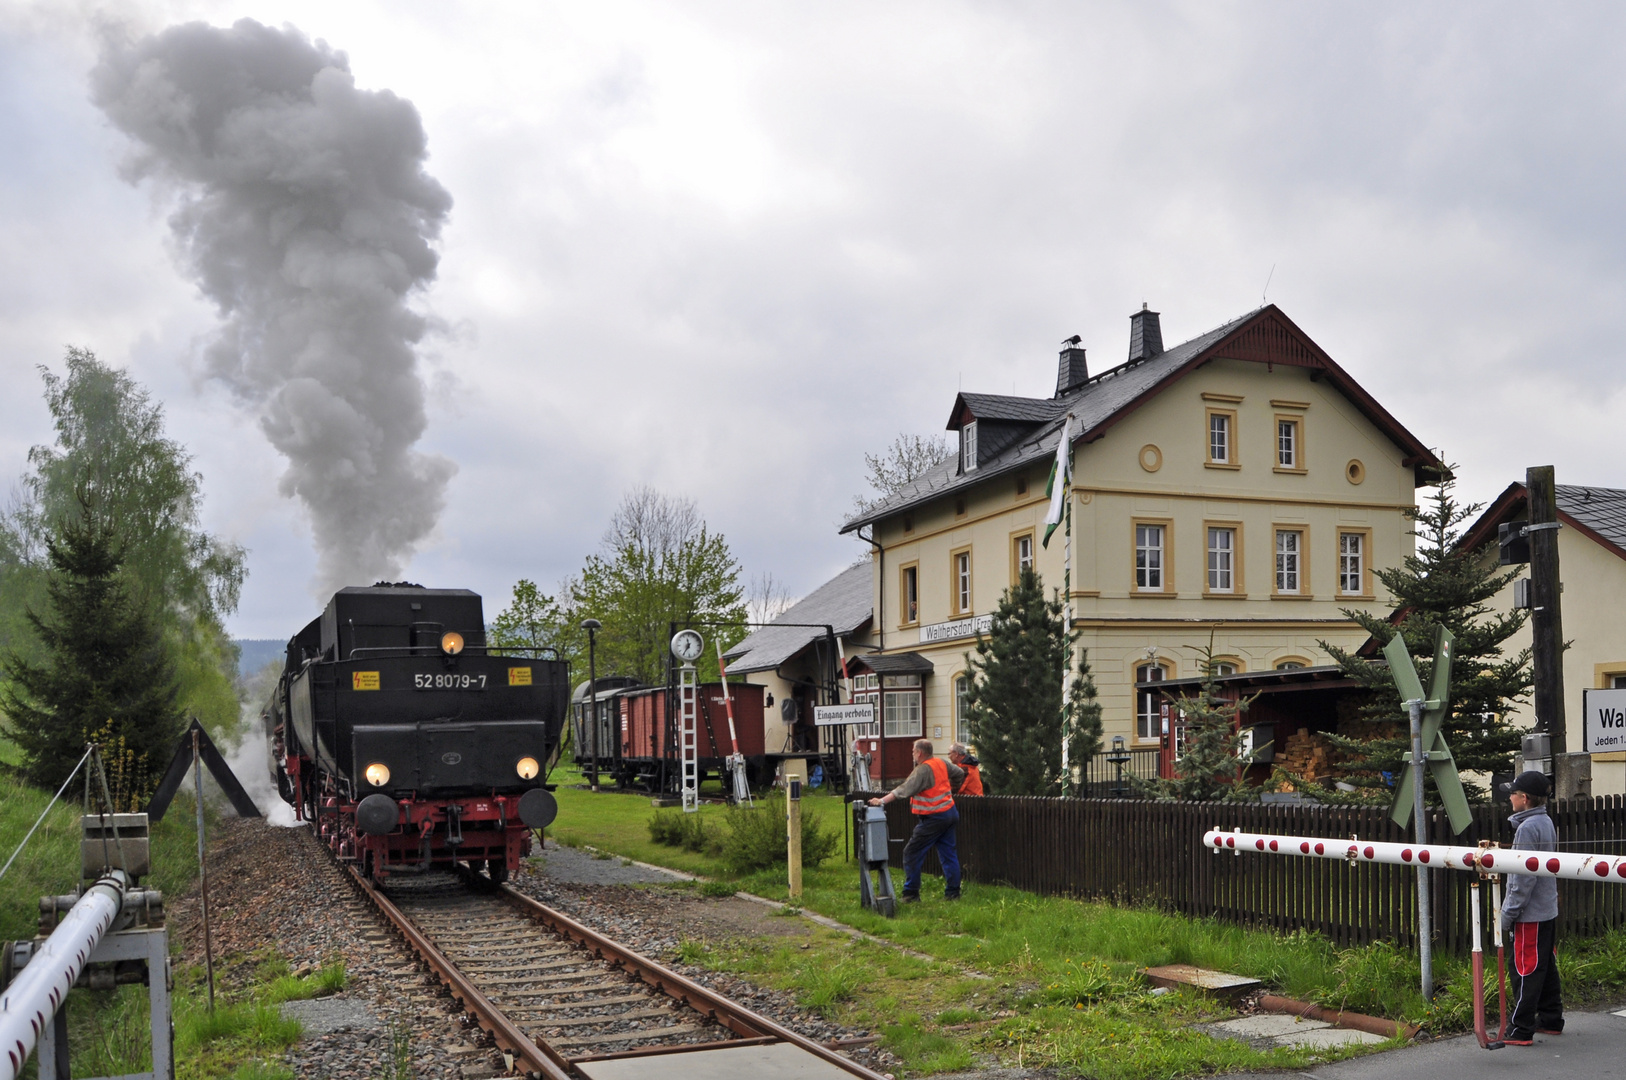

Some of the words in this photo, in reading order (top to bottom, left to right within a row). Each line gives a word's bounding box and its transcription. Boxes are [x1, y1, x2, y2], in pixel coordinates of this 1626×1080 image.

[926, 618, 974, 640] Walthersdorf
[974, 617, 992, 631] (Erzg
[415, 674, 432, 688] 52
[435, 674, 487, 688] 8079-7
[816, 709, 843, 721] Eingang
[844, 708, 872, 718] verboten
[1599, 708, 1626, 728] Wa
[1594, 735, 1618, 746] Jeden
